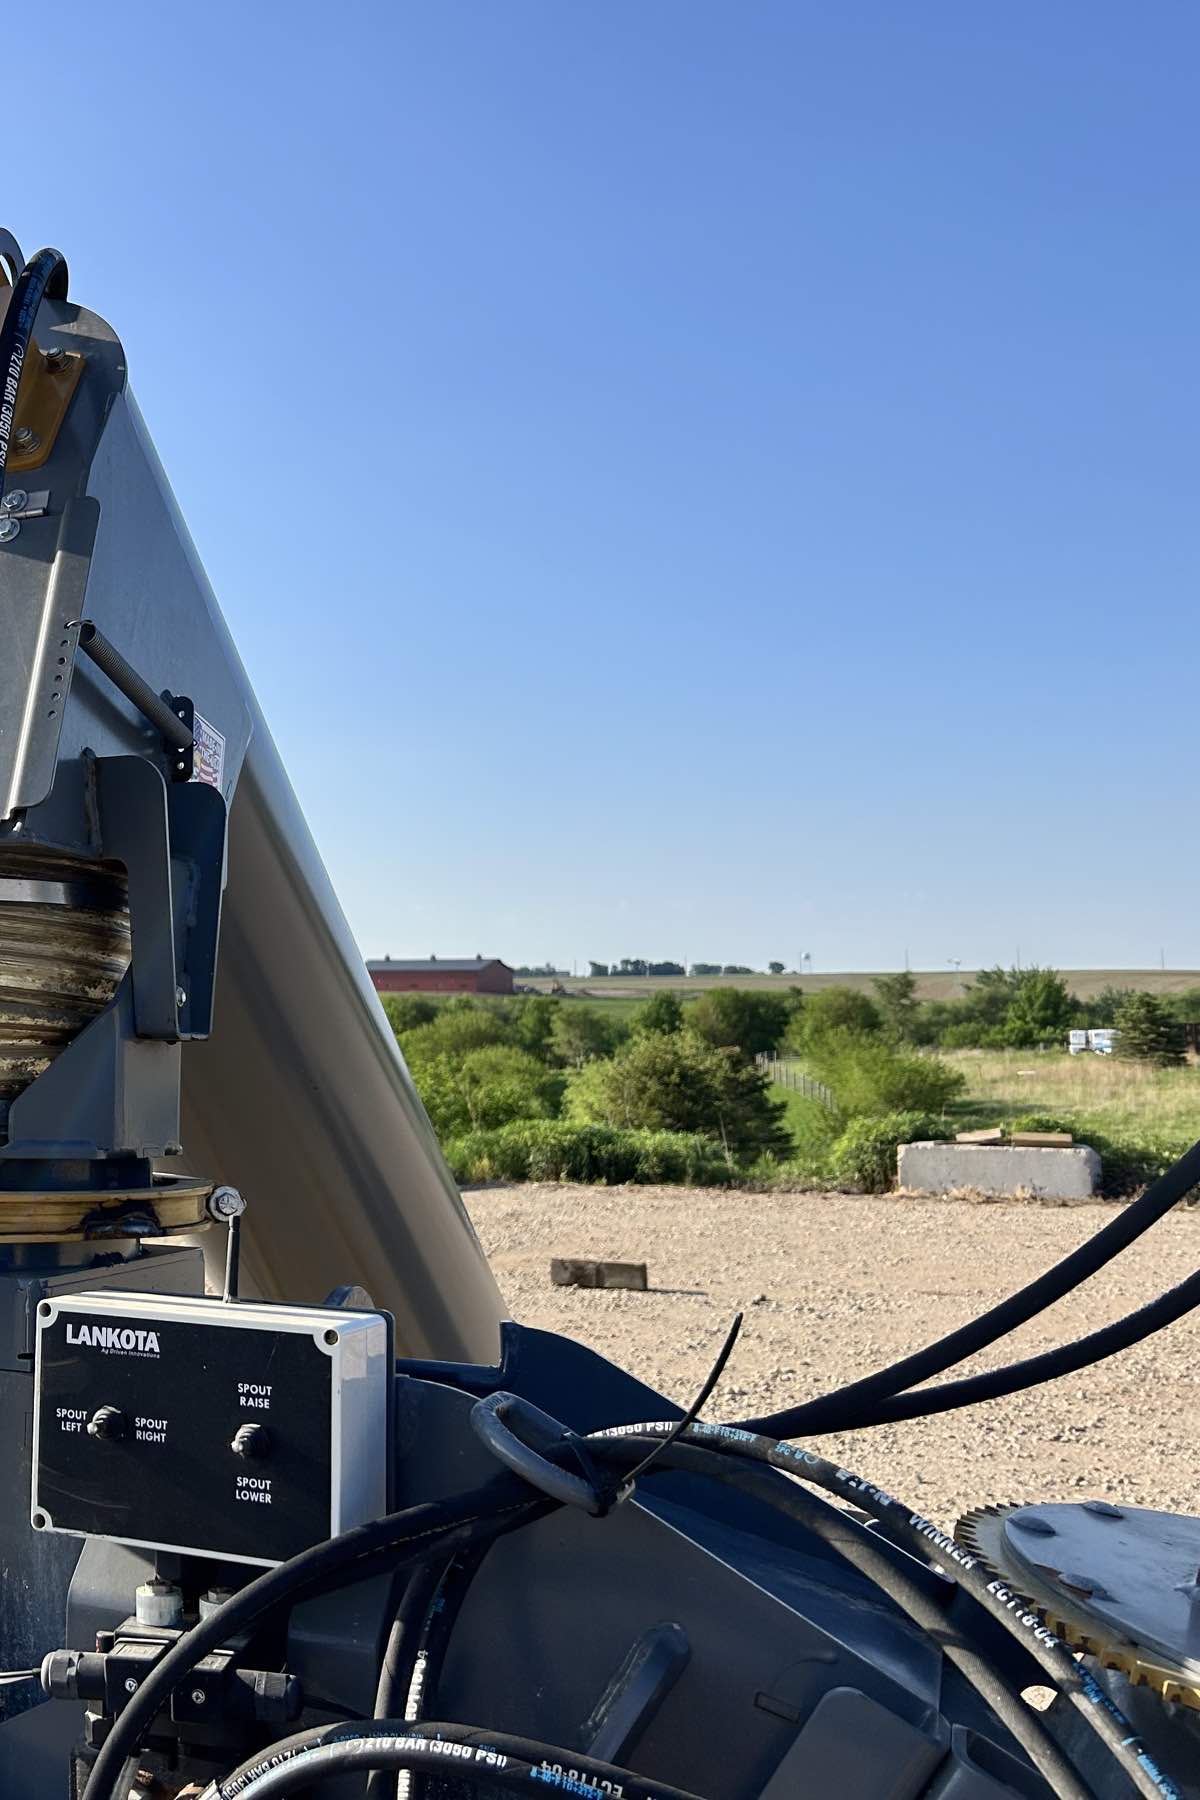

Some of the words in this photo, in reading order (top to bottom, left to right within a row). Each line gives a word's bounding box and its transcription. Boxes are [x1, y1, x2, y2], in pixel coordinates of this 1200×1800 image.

[7, 354, 22, 377] 210
[1, 376, 18, 403] BAR
[66, 1323, 160, 1352] LANKOTA
[238, 1383, 272, 1396] SPOUT
[239, 1396, 270, 1409] RAISE
[56, 1408, 87, 1420] SPOUT
[61, 1421, 81, 1432] LEFT
[135, 1417, 168, 1430] SPOUT
[136, 1430, 166, 1443] RIGHT
[236, 1476, 272, 1490] SPOUT
[235, 1489, 272, 1504] LOWER
[906, 1513, 976, 1571] WINNER
[984, 1577, 1059, 1652] EC118-04
[393, 1737, 427, 1753] BAR
[429, 1739, 472, 1760] (3050
[475, 1747, 507, 1768] PSI)
